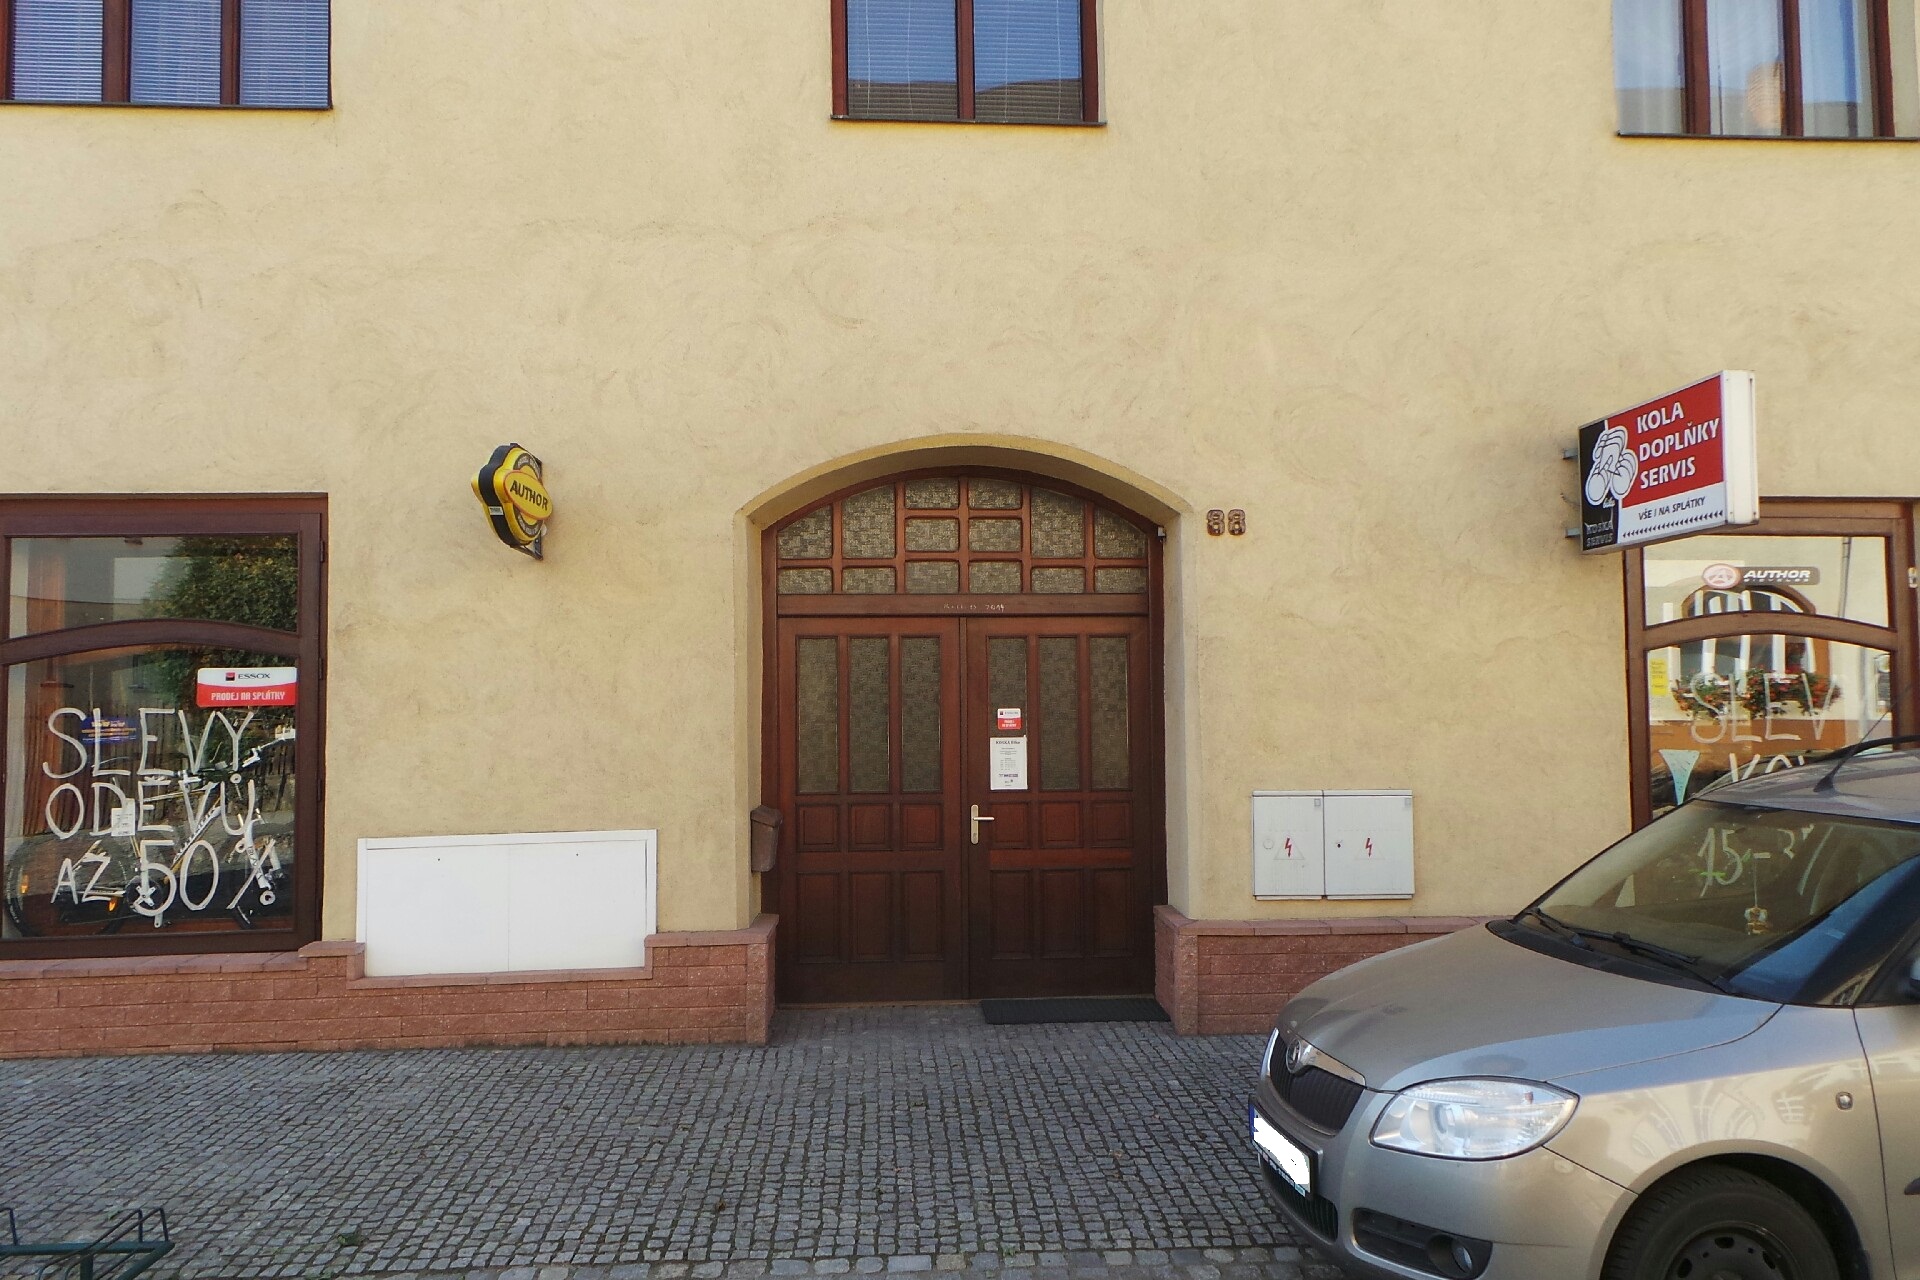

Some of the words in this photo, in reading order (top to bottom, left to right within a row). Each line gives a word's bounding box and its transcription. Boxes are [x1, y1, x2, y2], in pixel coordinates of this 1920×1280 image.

[1637, 402, 1684, 433] KOLA
[1640, 418, 1719, 461] DOPLŇKY
[1641, 457, 1695, 489] SERVIS
[510, 480, 548, 511] AUTHOR
[1638, 507, 1652, 520] VŠE
[1659, 505, 1670, 516] NA
[1672, 496, 1706, 513] SPLÁTKY
[1207, 509, 1246, 536] 88
[1743, 570, 1811, 579] AUTHOR
[211, 692, 239, 701] PRODEJ
[241, 692, 251, 700] NA
[252, 690, 286, 700] SPLÁTKY
[1690, 671, 1862, 743] SLEV
[43, 707, 255, 779] SLEVY
[50, 851, 112, 905] AŽ
